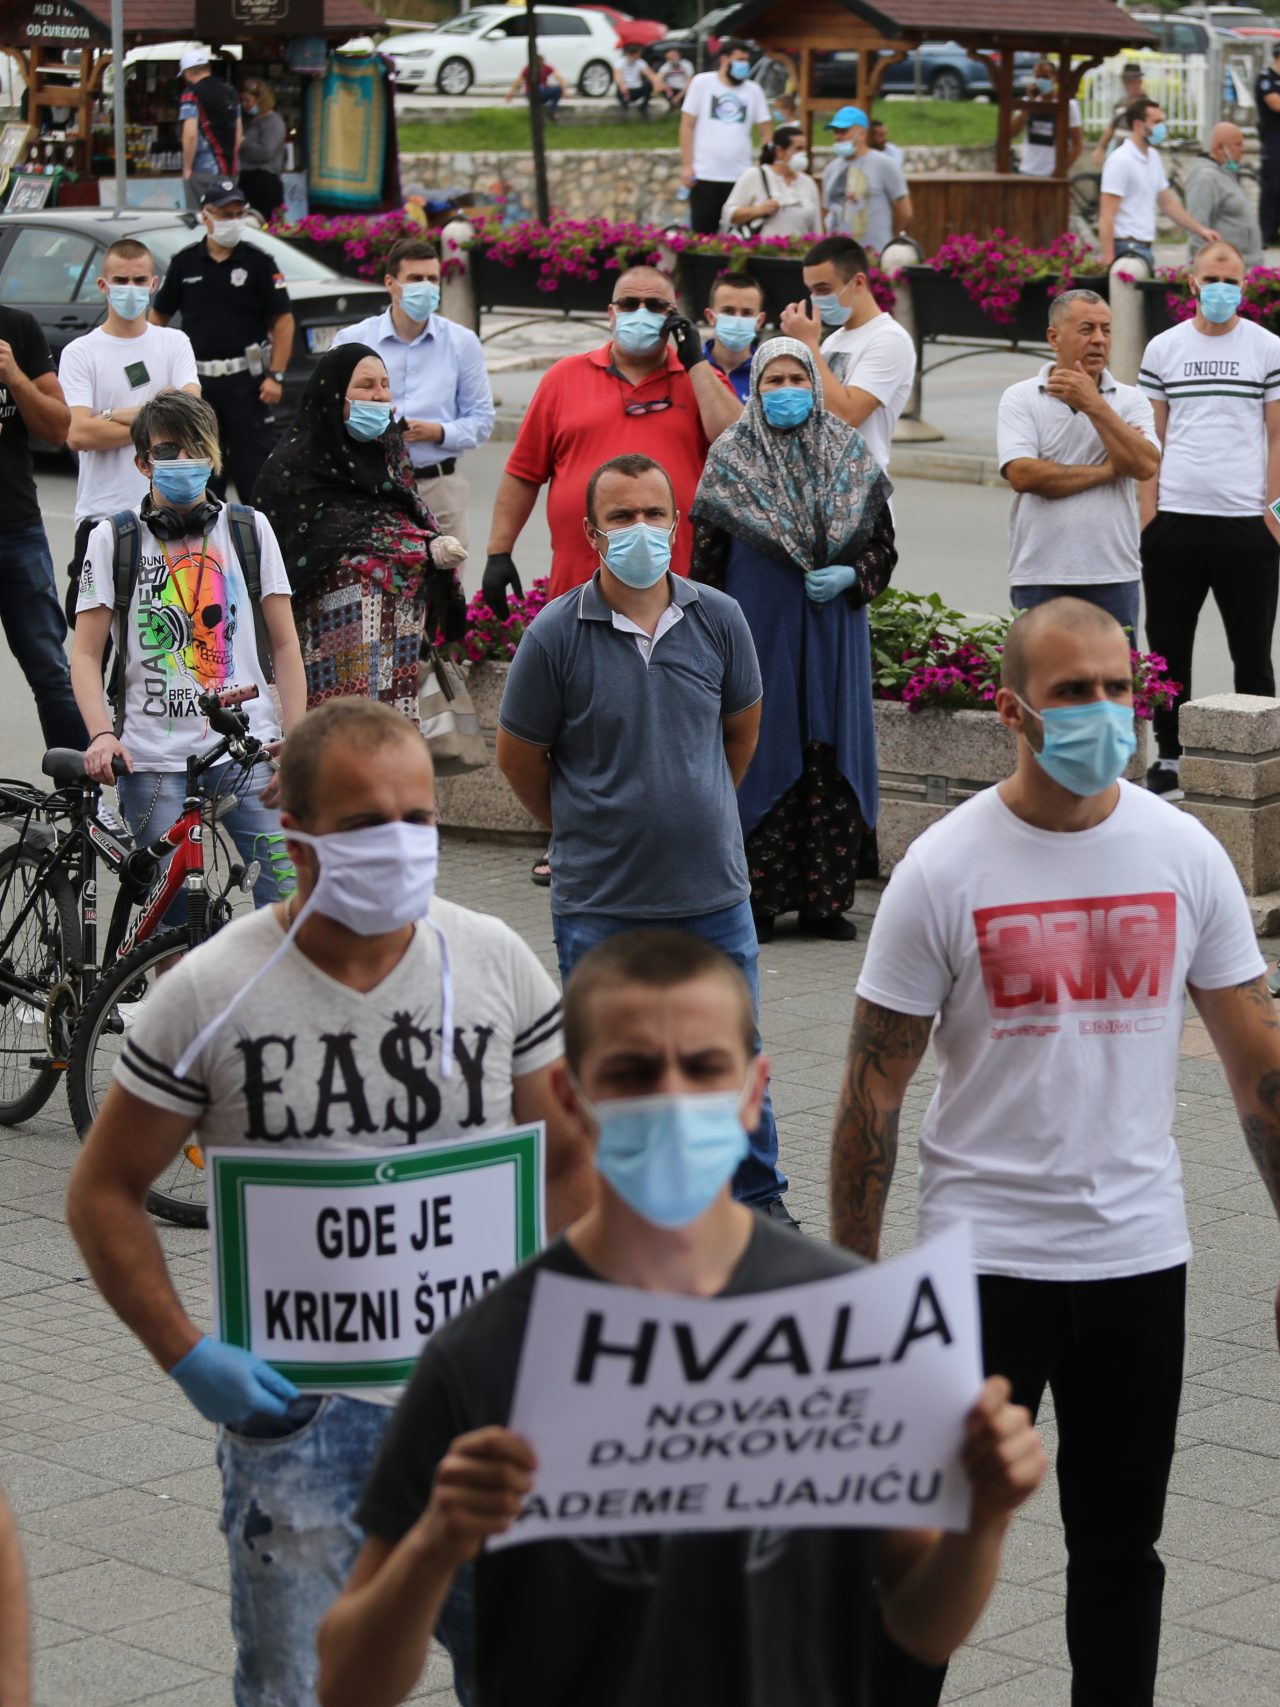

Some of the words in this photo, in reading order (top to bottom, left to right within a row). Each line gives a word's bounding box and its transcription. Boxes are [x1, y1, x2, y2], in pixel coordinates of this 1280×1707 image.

[1183, 361, 1240, 376] UNIQUE
[316, 1204, 397, 1259] GDE
[410, 1195, 453, 1252] JE
[264, 1289, 401, 1343] KRIZNI
[573, 1276, 953, 1387] HVALA
[645, 1386, 871, 1430] NOVAČE
[588, 1414, 905, 1468] DJOKOVIĆU
[517, 1483, 708, 1522] ADEME
[725, 1463, 945, 1513] LJAJIĆU
